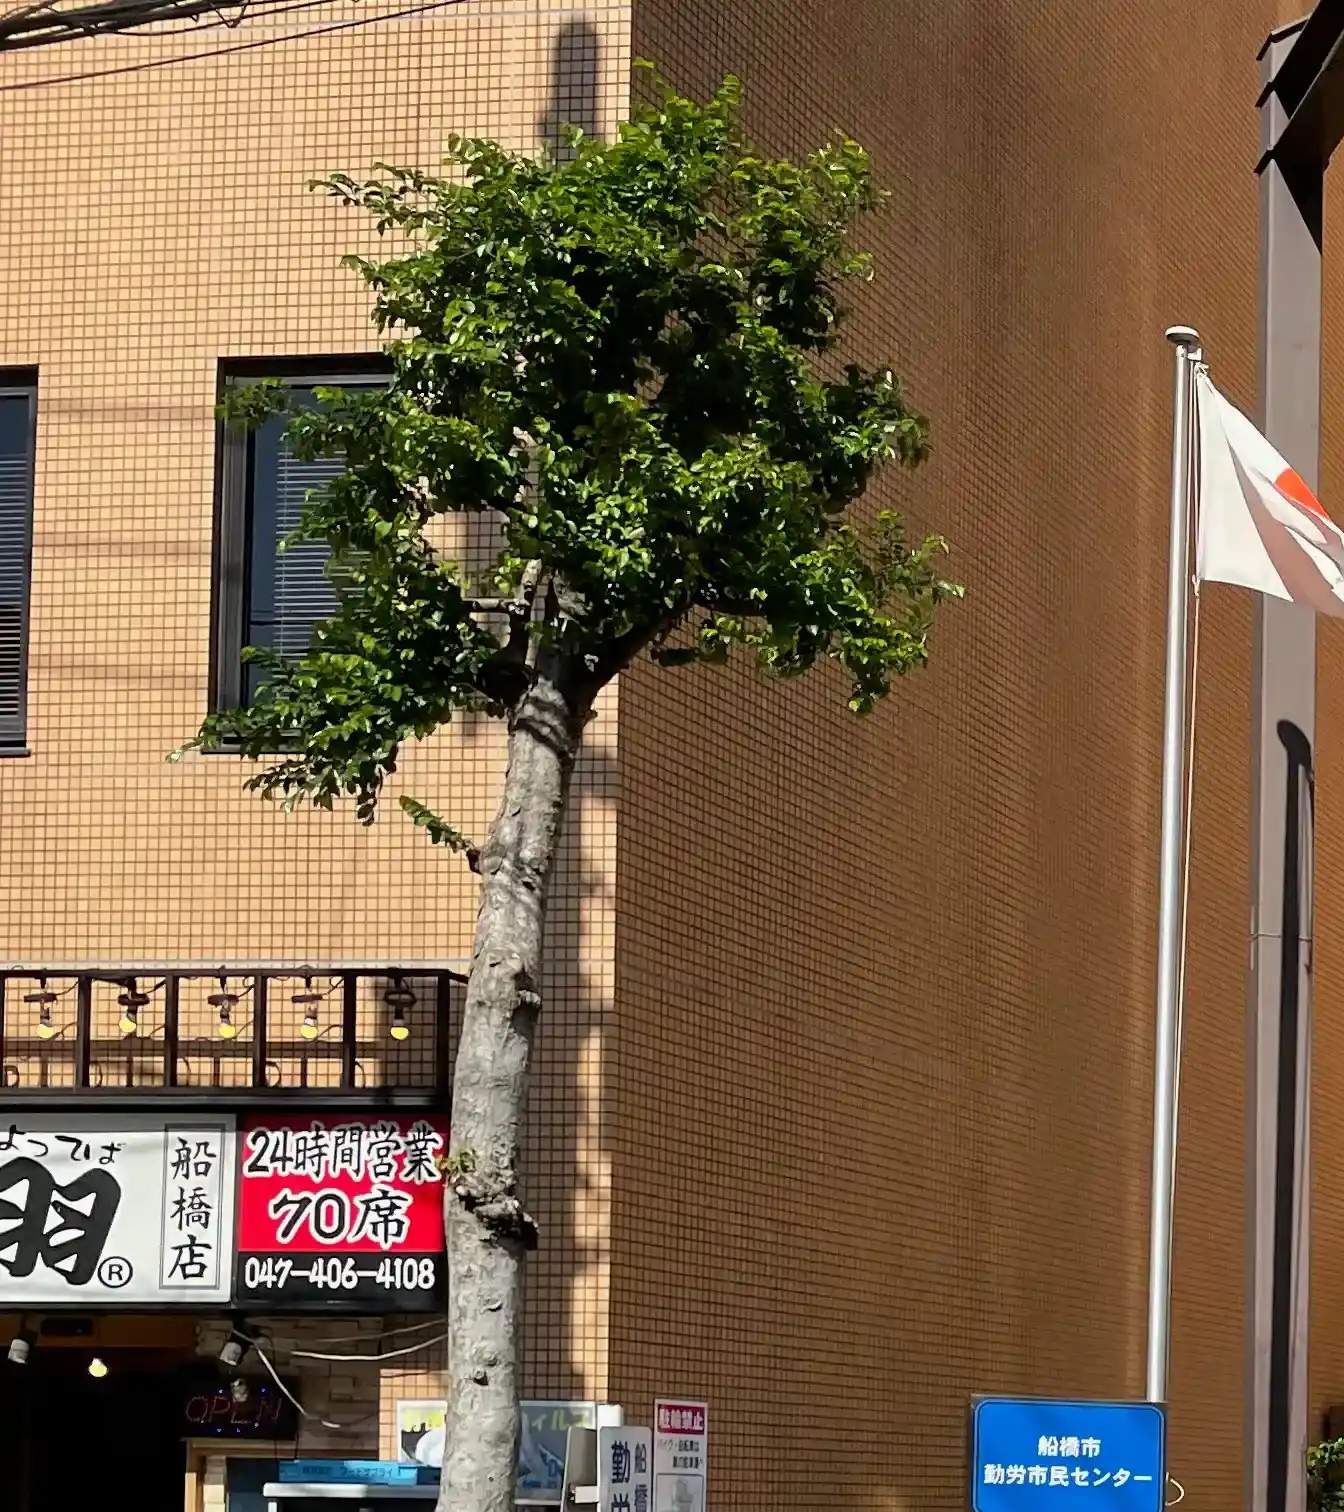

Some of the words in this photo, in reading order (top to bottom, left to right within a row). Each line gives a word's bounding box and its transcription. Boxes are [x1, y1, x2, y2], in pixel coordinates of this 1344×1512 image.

[244, 1122, 443, 1182] 24時間営業
[168, 1136, 217, 1280] 船橋店
[268, 1183, 413, 1250] 70席
[244, 1256, 436, 1290] 047-406-4108
[1037, 1435, 1102, 1458] 船橋市
[983, 1463, 1153, 1488] 勤労市民センター
